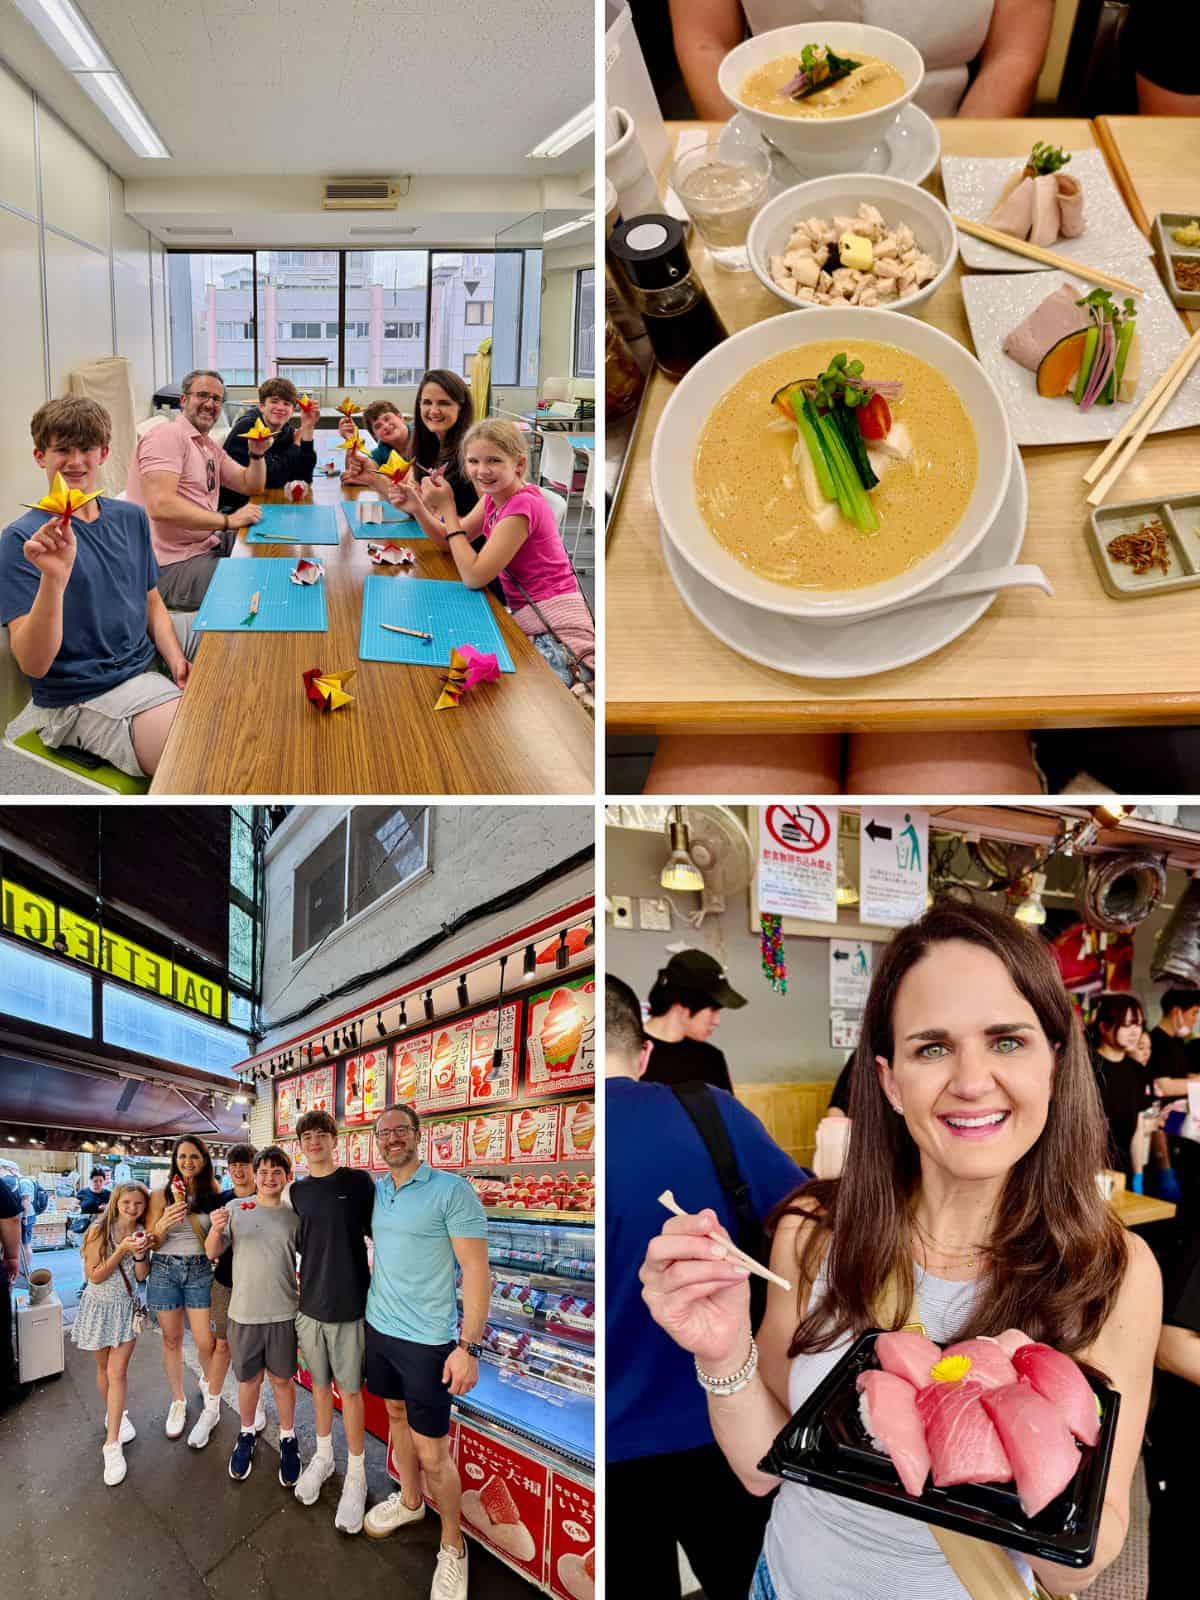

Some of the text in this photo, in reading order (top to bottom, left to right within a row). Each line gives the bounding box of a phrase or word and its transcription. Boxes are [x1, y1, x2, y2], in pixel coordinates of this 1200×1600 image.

[463, 1443, 541, 1497] いちご大福
